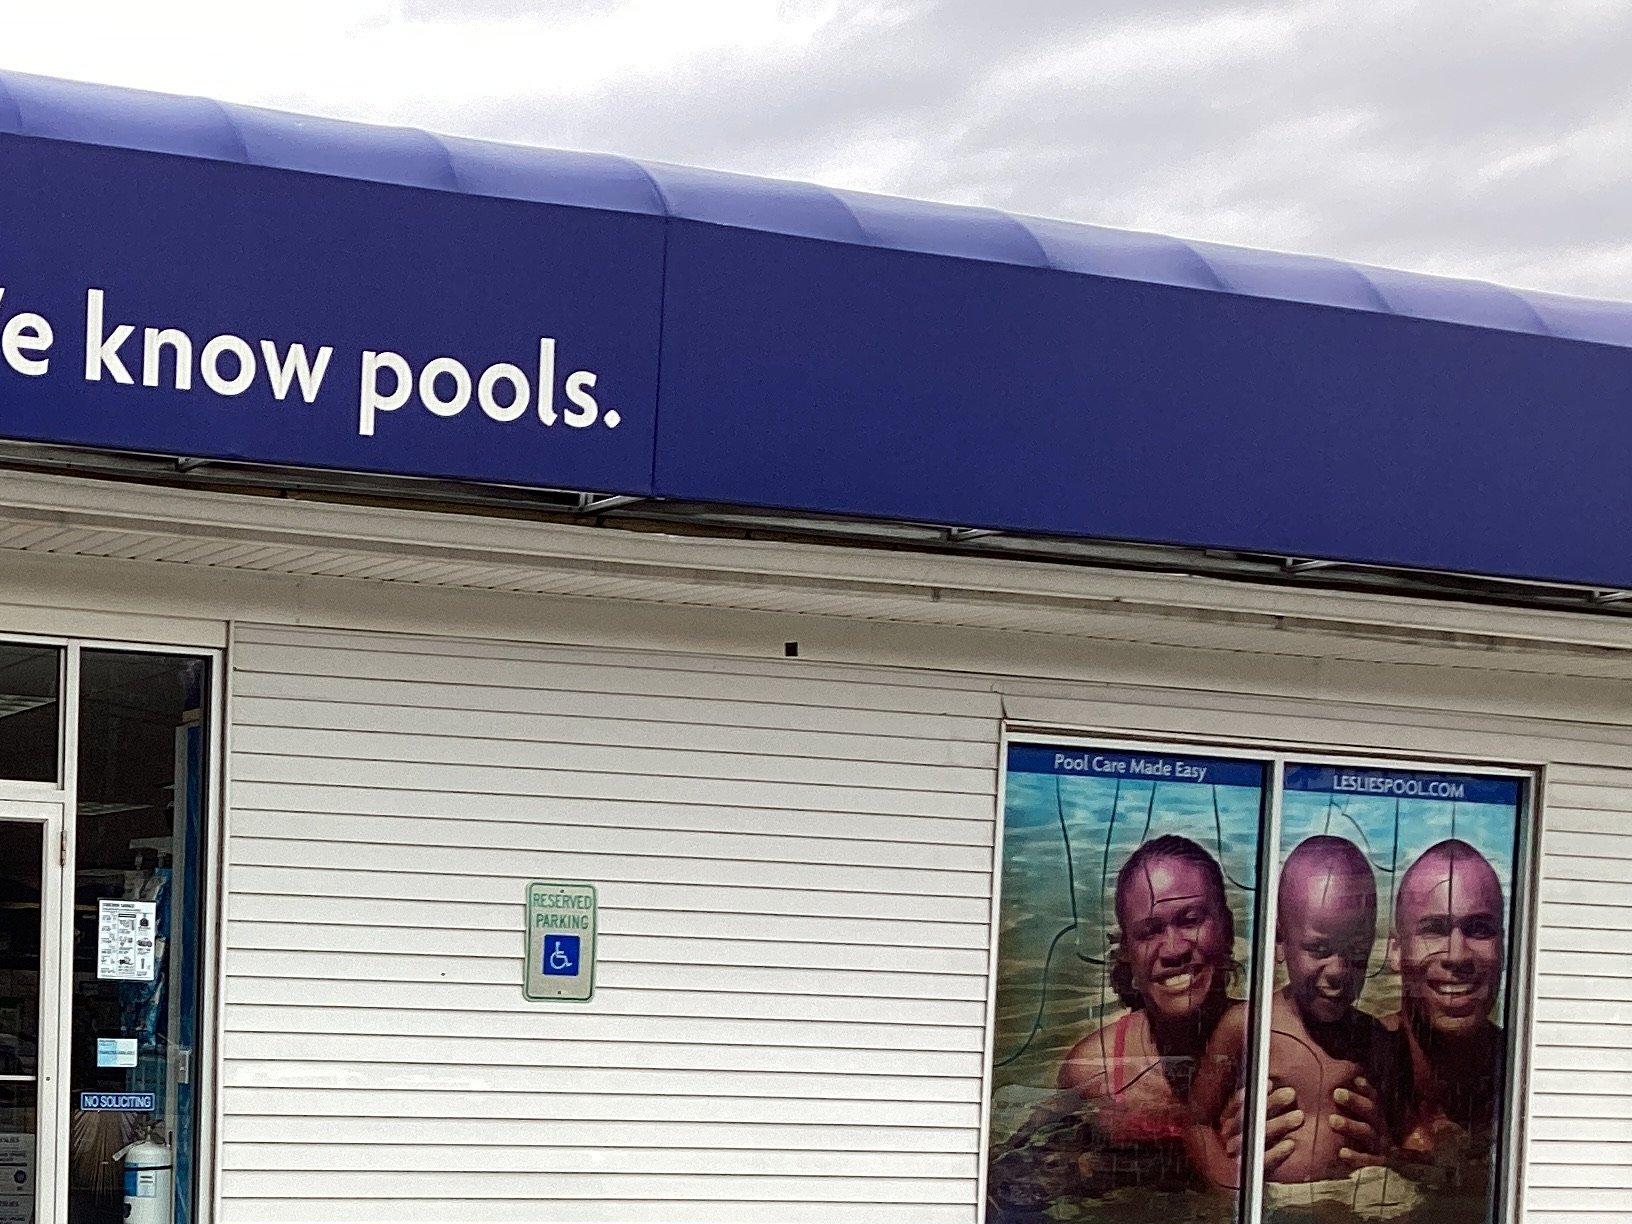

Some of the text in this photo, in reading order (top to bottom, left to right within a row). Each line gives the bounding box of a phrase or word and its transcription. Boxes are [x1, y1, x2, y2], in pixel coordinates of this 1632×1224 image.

[84, 287, 334, 404] know
[357, 337, 623, 437] pools.
[1054, 753, 1207, 782] Pool Care Made Easy
[1333, 775, 1465, 798] LESLIESPOOL.COM
[533, 893, 593, 909] RESERVED
[536, 914, 589, 929] PARKING
[84, 1096, 151, 1108] NO SOLICITING
